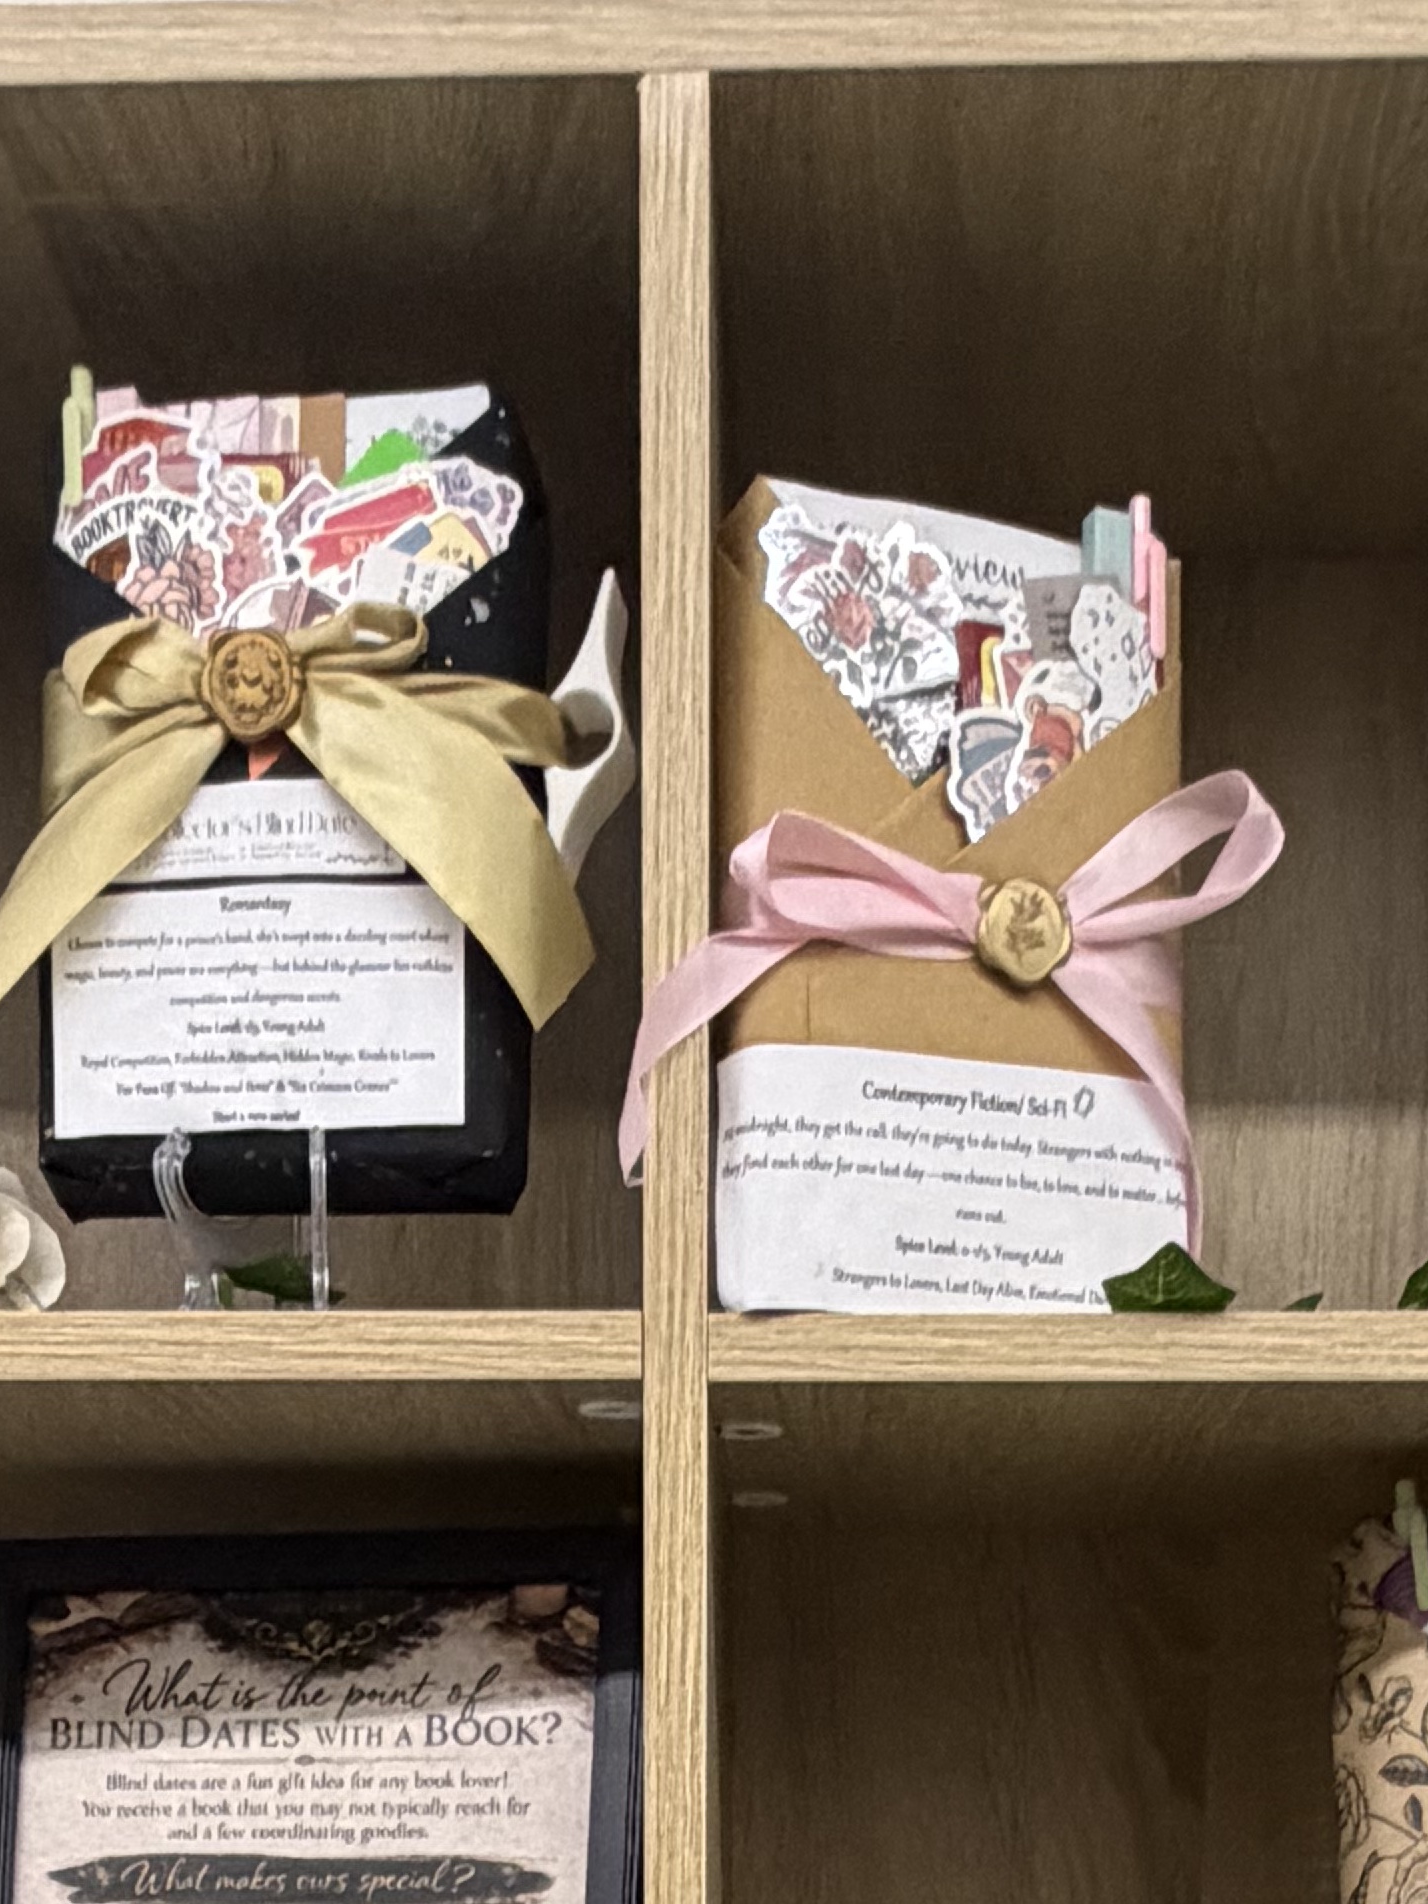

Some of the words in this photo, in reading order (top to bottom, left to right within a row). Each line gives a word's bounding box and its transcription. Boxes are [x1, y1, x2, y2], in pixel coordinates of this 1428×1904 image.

[103, 1659, 225, 1717] What
[232, 1678, 266, 1708] is
[277, 1663, 327, 1709] the
[336, 1673, 432, 1720] point
[447, 1665, 502, 1726] of
[50, 1719, 163, 1750] BLIND
[179, 1718, 300, 1750] DATES
[316, 1726, 383, 1747] WITH
[395, 1725, 412, 1747] A
[425, 1713, 562, 1747] BOOK?
[106, 1771, 147, 1791] Blind
[153, 1772, 198, 1791] dates
[201, 1777, 227, 1791] are
[232, 1778, 241, 1790] a
[246, 1772, 273, 1791] fun
[279, 1771, 306, 1793] gift
[310, 1772, 344, 1791] idea
[350, 1771, 374, 1790] for
[379, 1776, 409, 1794] any
[415, 1771, 454, 1790] book
[460, 1771, 507, 1790] lover!
[82, 1802, 111, 1819] You
[117, 1803, 172, 1819] receive
[178, 1805, 186, 1817] a
[192, 1799, 231, 1817] book
[237, 1800, 268, 1817] that
[275, 1804, 303, 1821] you
[310, 1804, 343, 1820] may
[348, 1802, 376, 1817] not
[382, 1798, 449, 1820] typically
[454, 1798, 500, 1816] reach
[506, 1797, 530, 1816] for
[167, 1822, 198, 1840] and
[204, 1827, 212, 1839] a
[217, 1822, 246, 1840] few
[250, 1821, 356, 1845] coordinating
[361, 1822, 429, 1843] goodies.
[121, 1861, 205, 1897] What
[214, 1865, 288, 1894] makes
[295, 1870, 349, 1894] ours
[360, 1861, 476, 1900] special?
